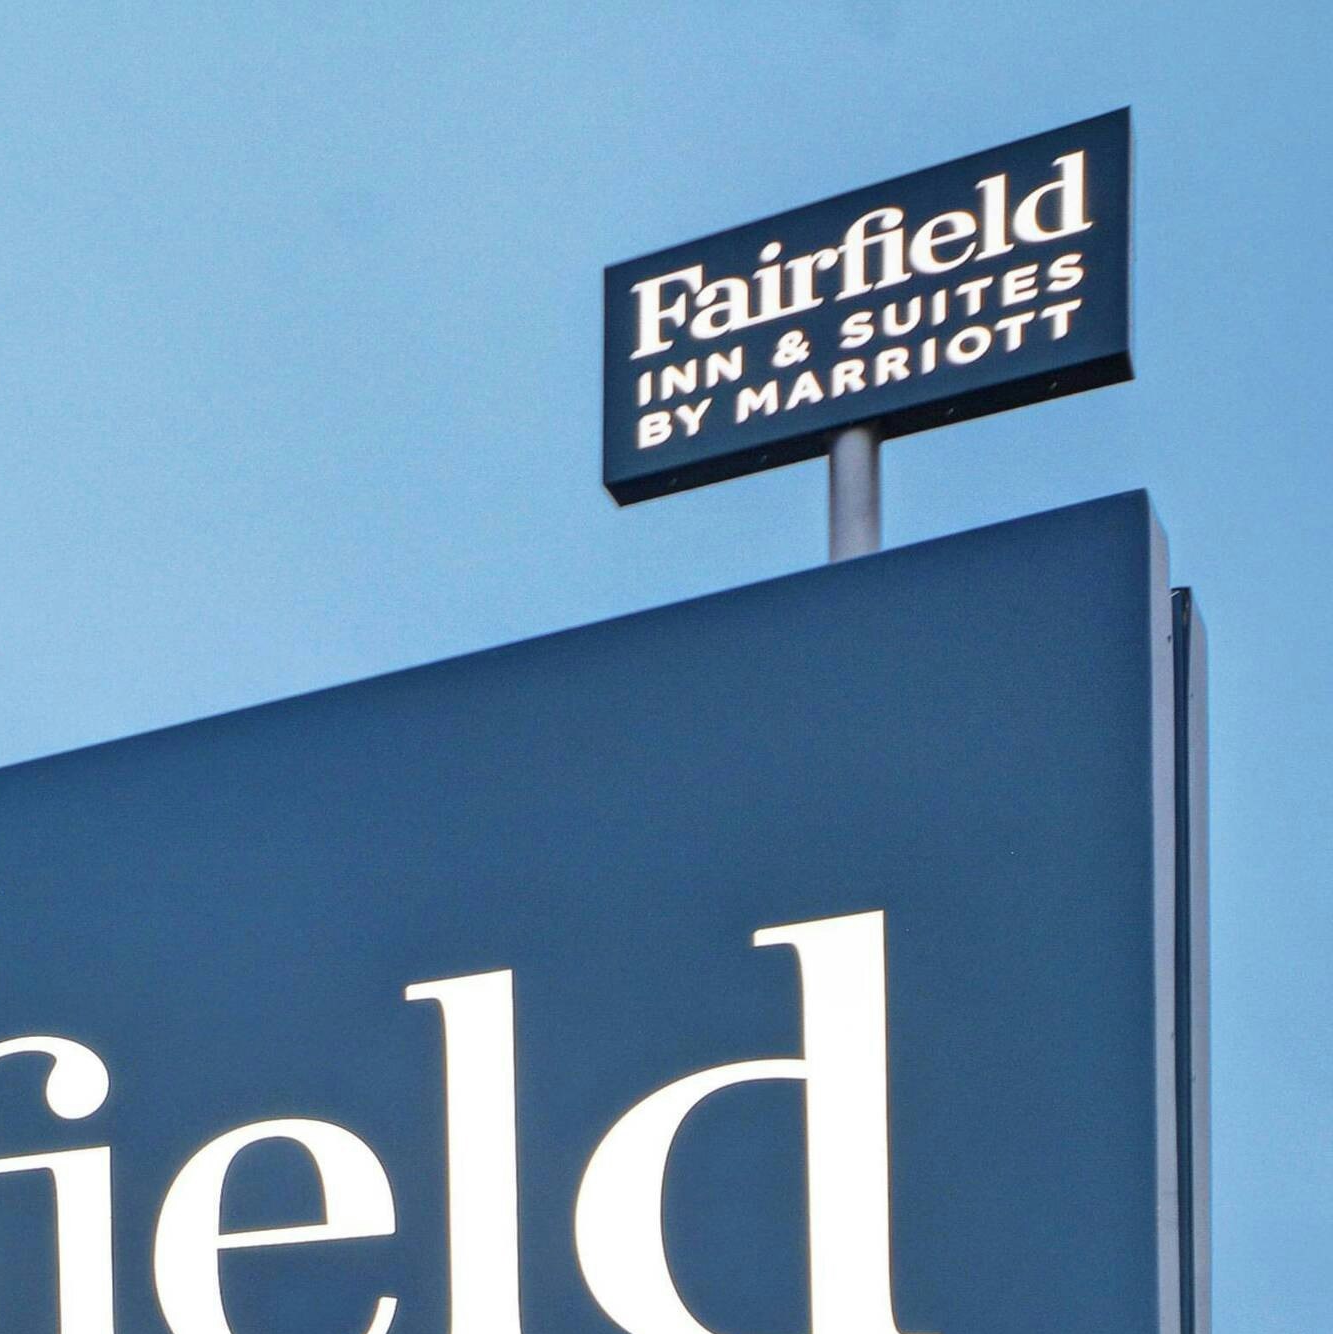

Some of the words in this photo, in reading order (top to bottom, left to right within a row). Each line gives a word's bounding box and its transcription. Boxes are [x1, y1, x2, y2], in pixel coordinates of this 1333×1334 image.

[629, 149, 1094, 360] Fairfield
[637, 345, 744, 407] INN
[771, 329, 811, 369] &
[839, 252, 1085, 350] SUITES
[637, 397, 713, 450] BY
[734, 297, 1083, 425] MARRIOTT
